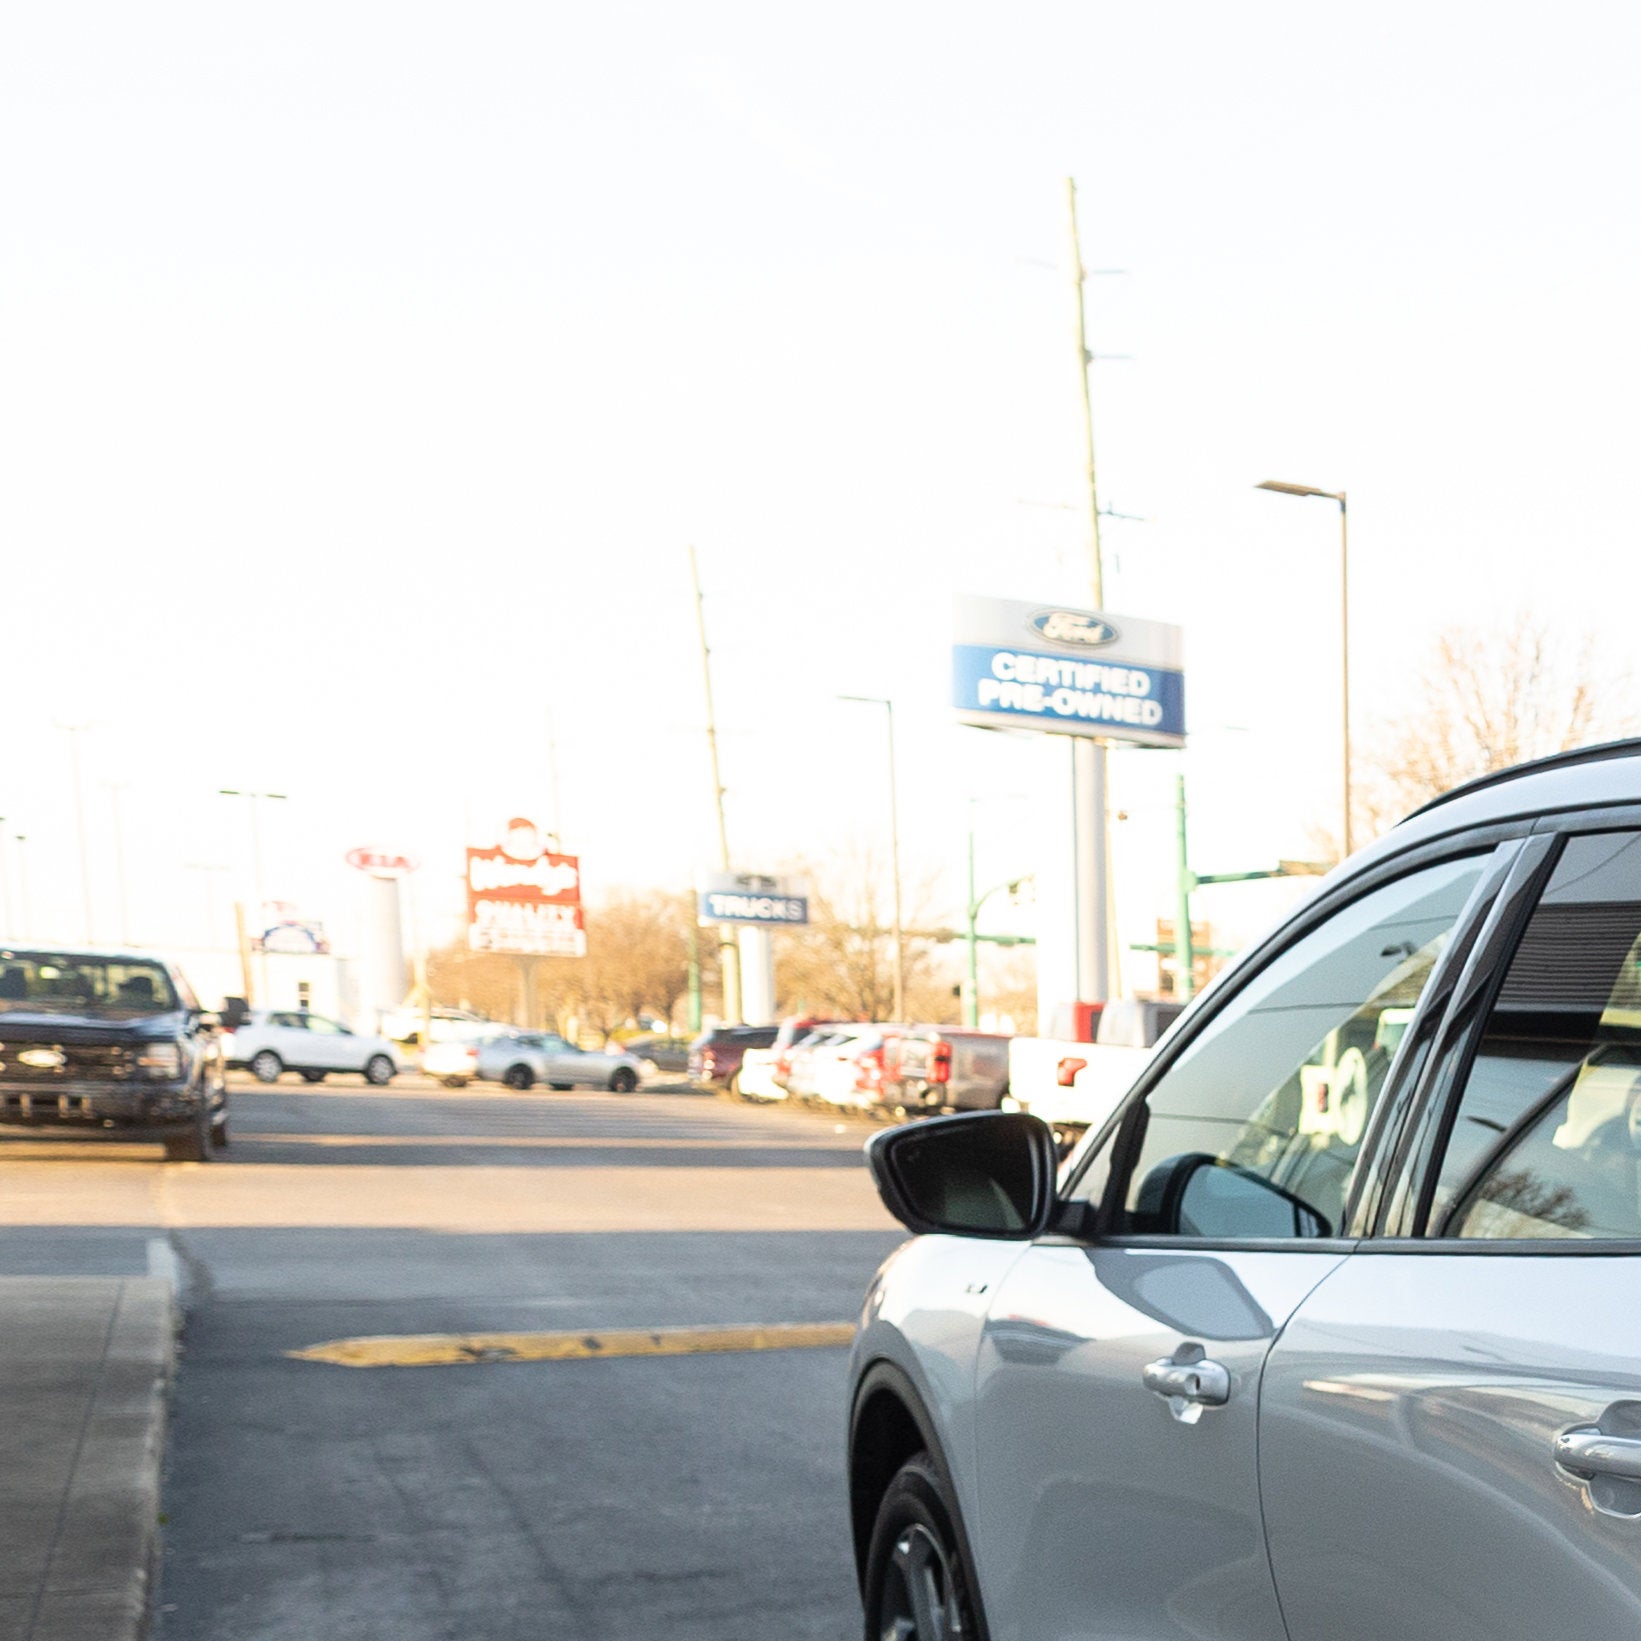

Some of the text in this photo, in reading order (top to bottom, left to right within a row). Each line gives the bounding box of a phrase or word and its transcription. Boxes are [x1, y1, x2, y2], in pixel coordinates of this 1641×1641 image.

[991, 652, 1151, 697] CERTIFIED
[978, 678, 1163, 726] PRE-OWNED
[709, 893, 803, 921] TRUCKS
